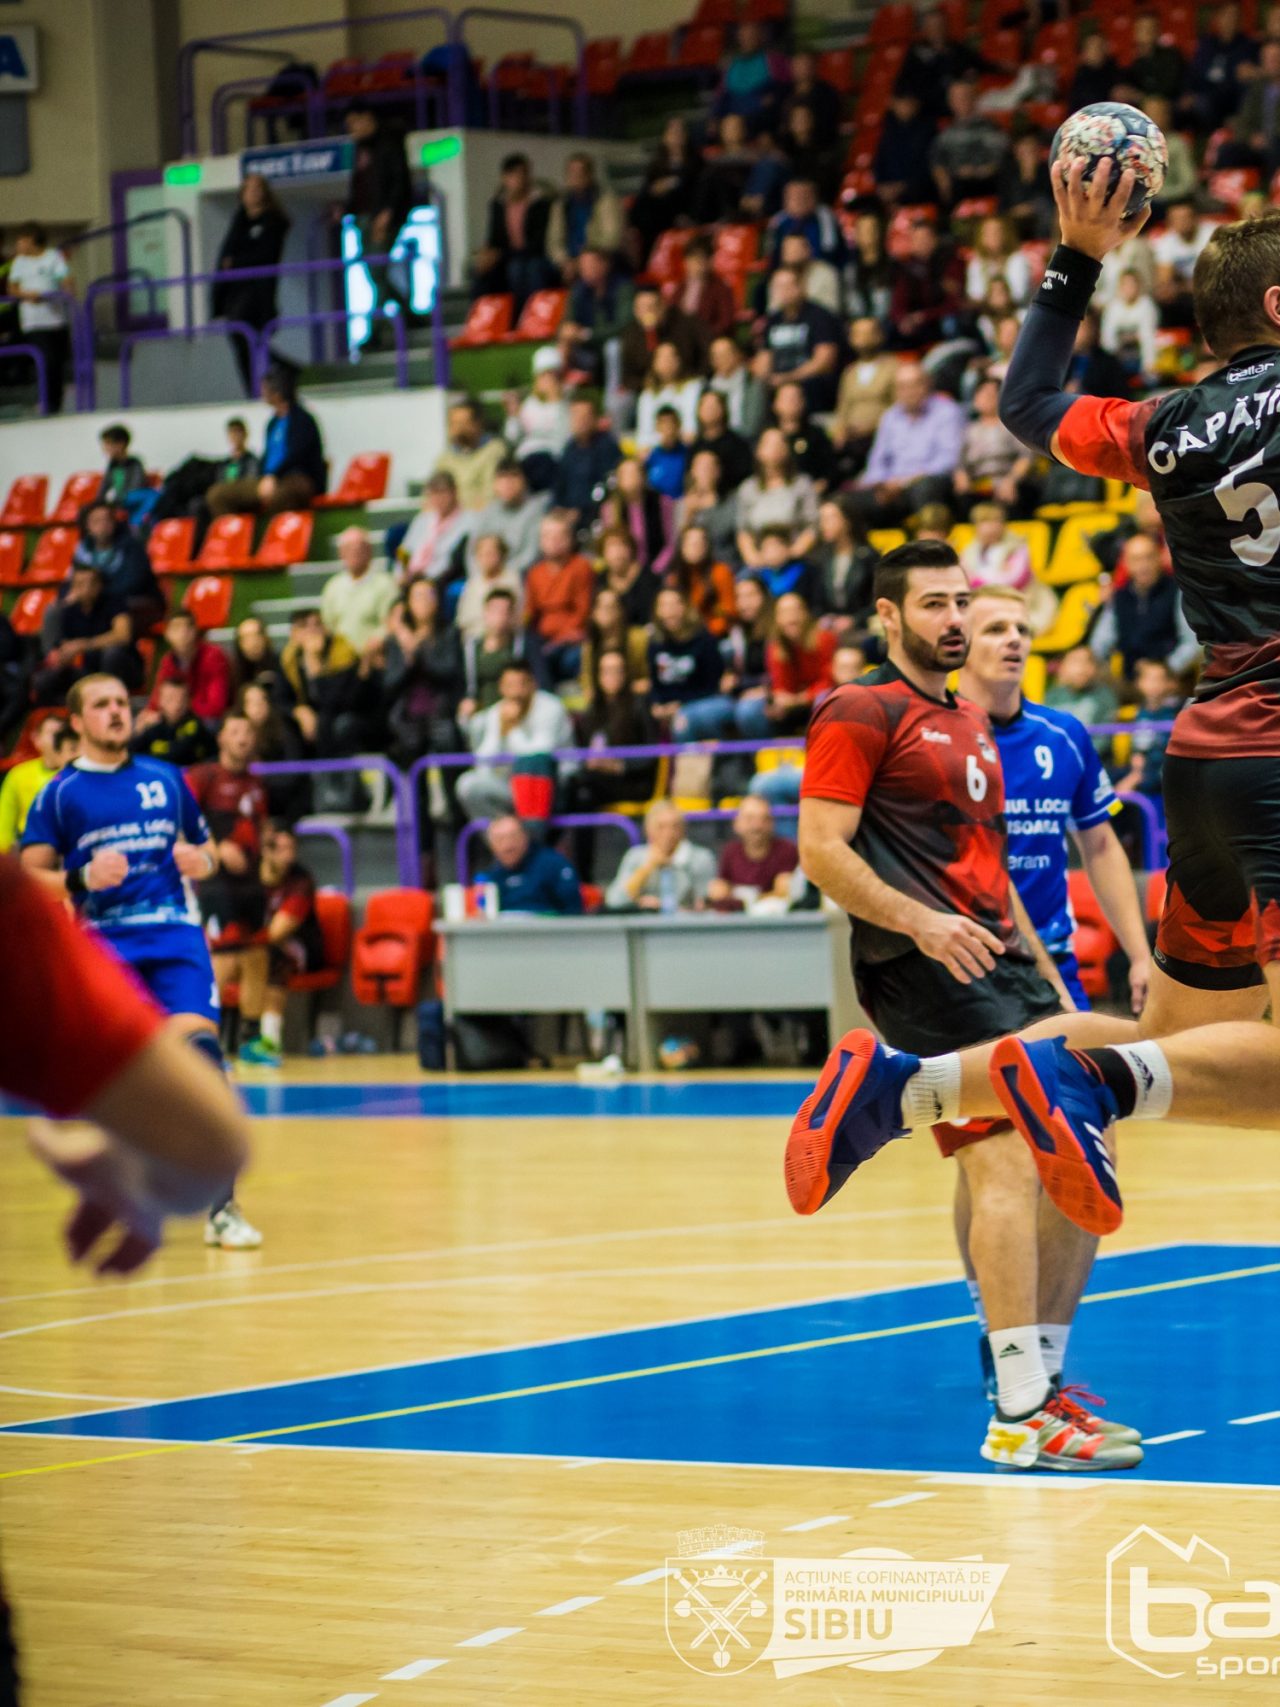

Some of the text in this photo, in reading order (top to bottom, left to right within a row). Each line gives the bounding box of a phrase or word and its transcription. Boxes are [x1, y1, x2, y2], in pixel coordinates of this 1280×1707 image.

[966, 754, 988, 803] 6
[1033, 744, 1054, 780] 9
[135, 780, 168, 811] 13
